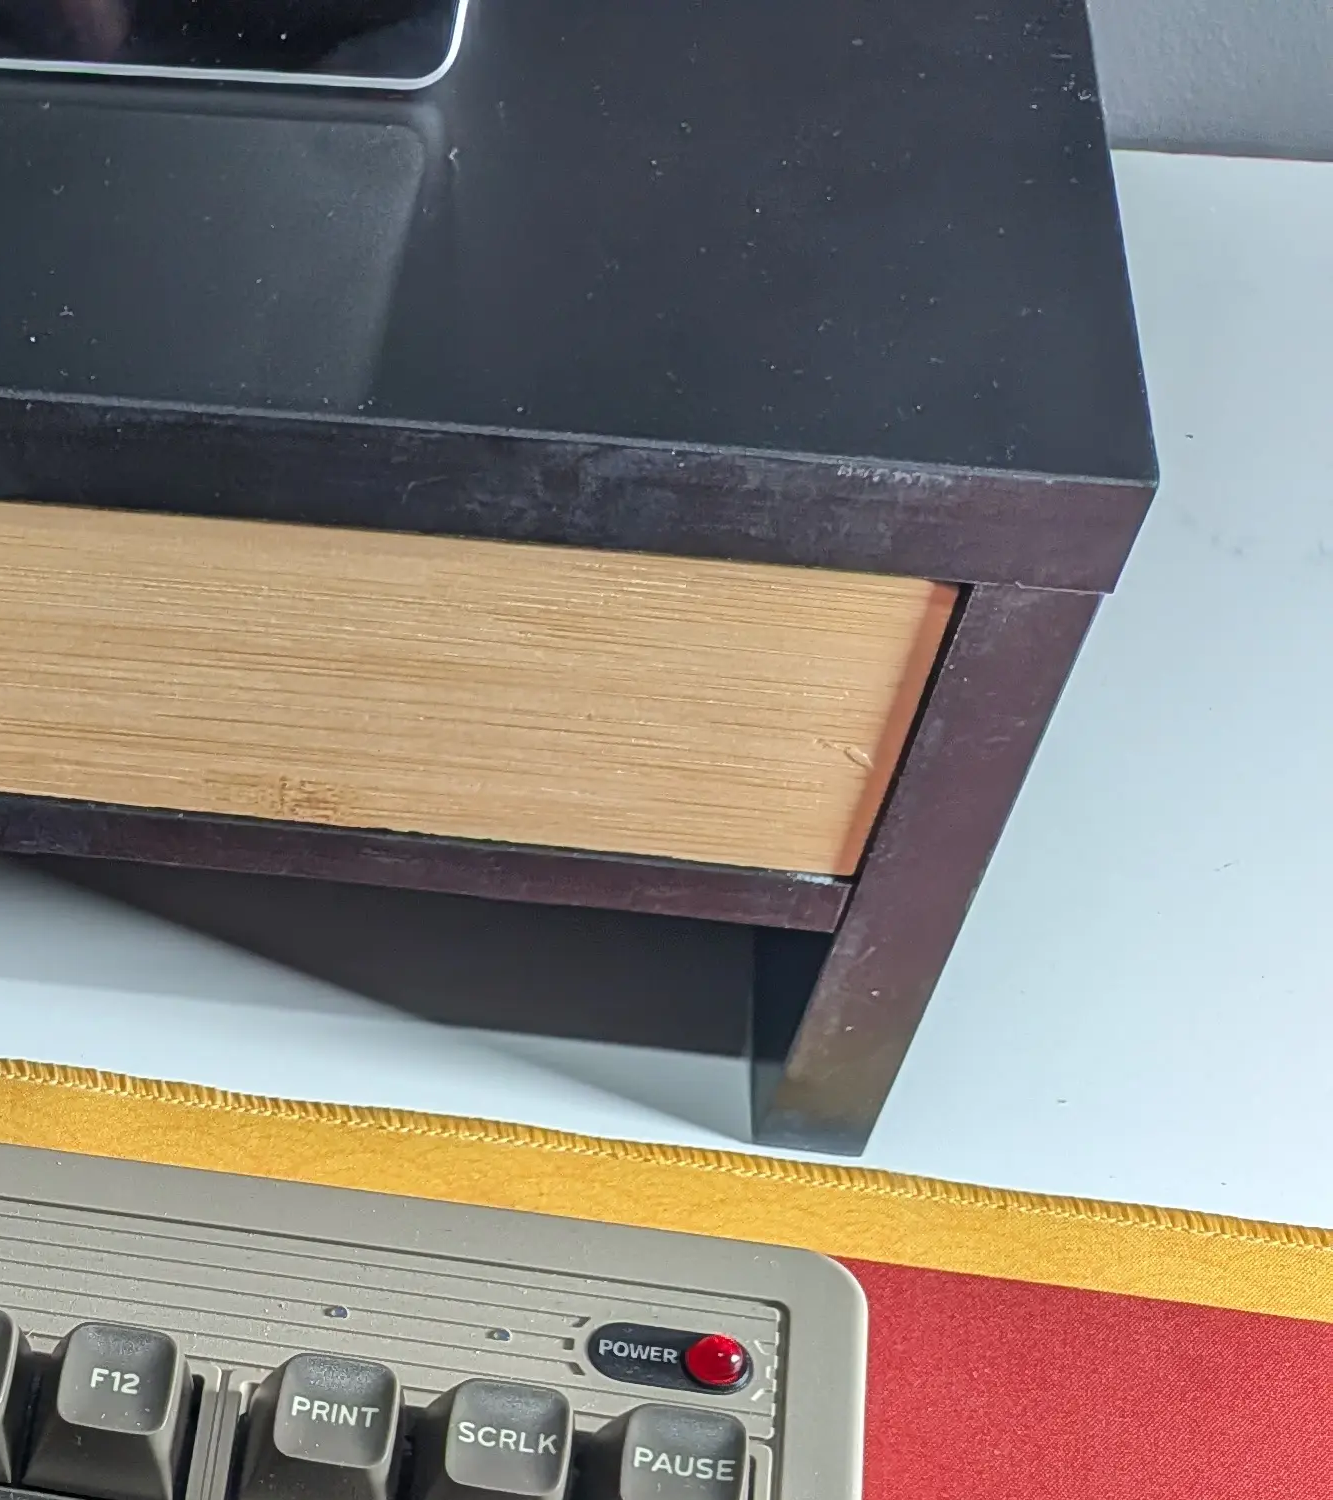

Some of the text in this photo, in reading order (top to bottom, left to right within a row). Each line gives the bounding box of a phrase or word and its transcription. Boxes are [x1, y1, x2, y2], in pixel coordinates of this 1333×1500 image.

[598, 1339, 678, 1364] POWER
[90, 1367, 140, 1395] F12
[291, 1395, 379, 1428] PRINT
[457, 1421, 558, 1455] SCRLK
[633, 1446, 736, 1482] PAUSE
